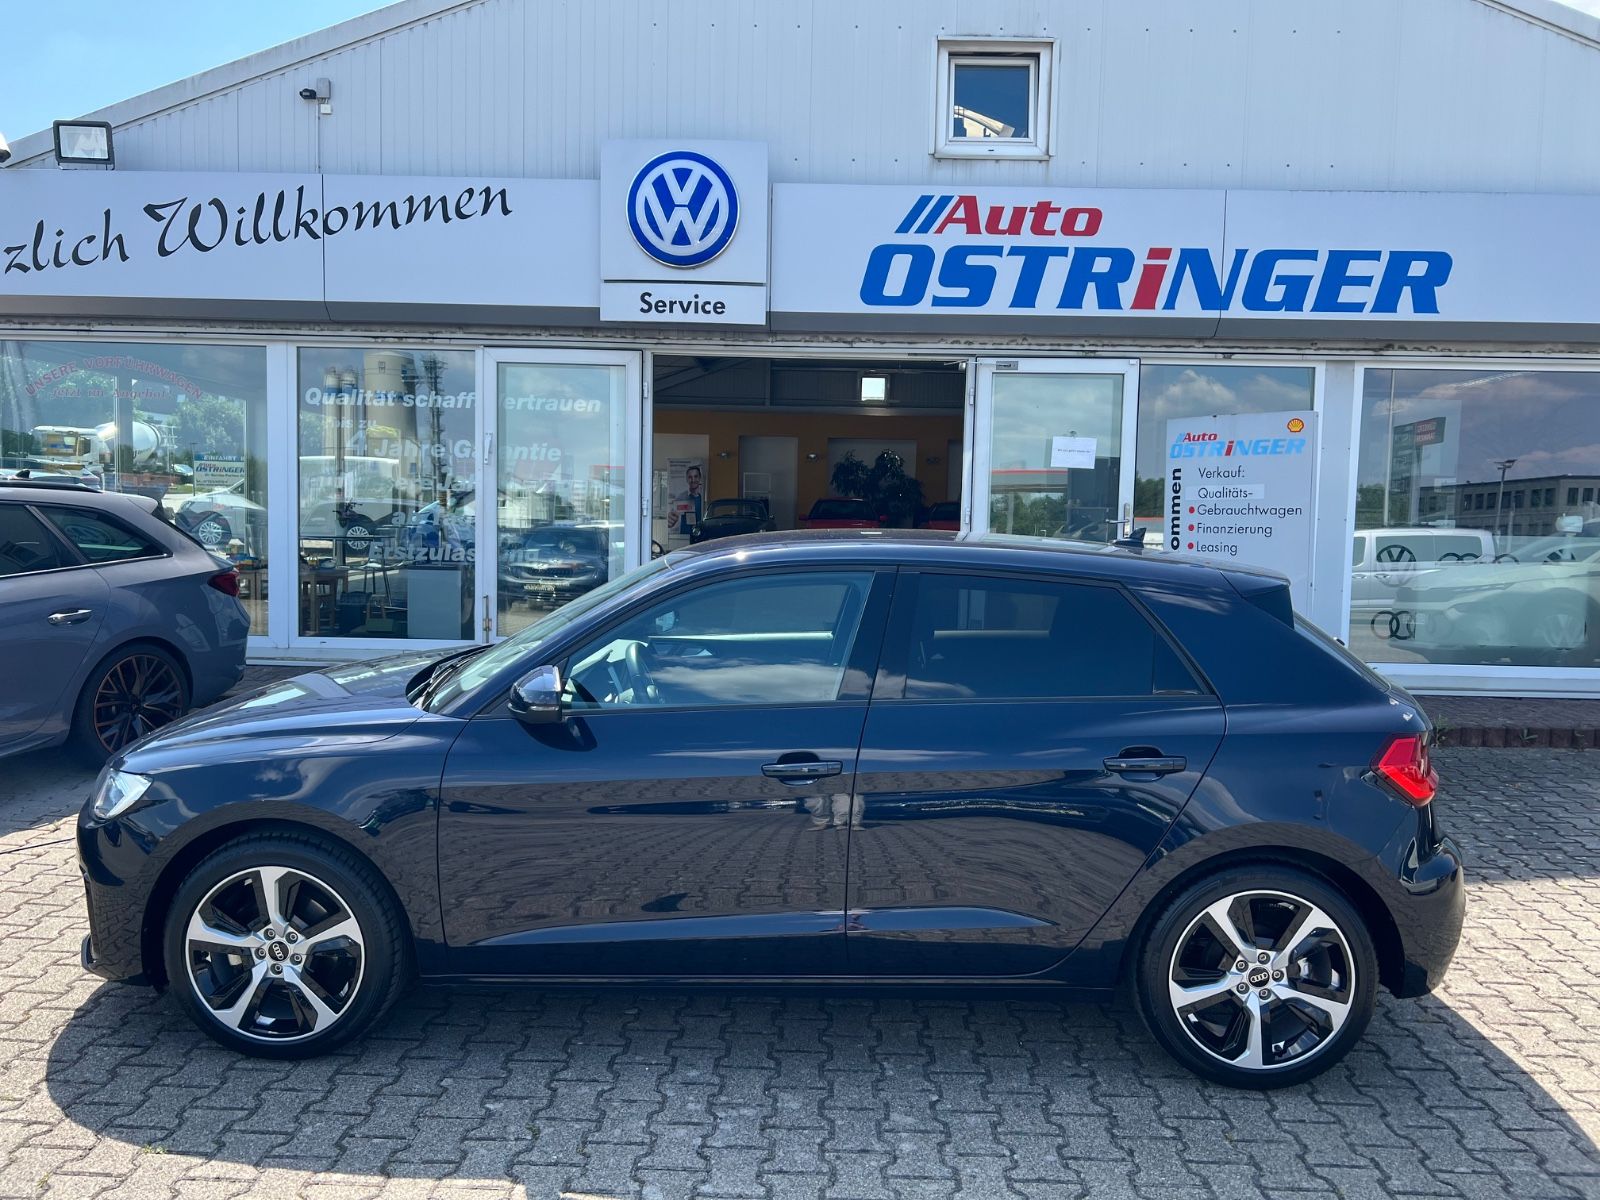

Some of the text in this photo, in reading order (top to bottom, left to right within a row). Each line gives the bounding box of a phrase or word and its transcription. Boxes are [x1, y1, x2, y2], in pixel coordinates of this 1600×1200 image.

[143, 184, 513, 258] Willkommen
[639, 291, 727, 316] Service
[304, 387, 601, 413] Qualität schaff ertrauen
[374, 438, 446, 459] Jahre
[1198, 465, 1245, 479] Verkauf:
[1197, 486, 1254, 500] Qualitäts-
[1197, 503, 1303, 519] Gebrauchtwagen
[1196, 523, 1273, 538] Finanzierung
[1196, 541, 1238, 556] Leasing
